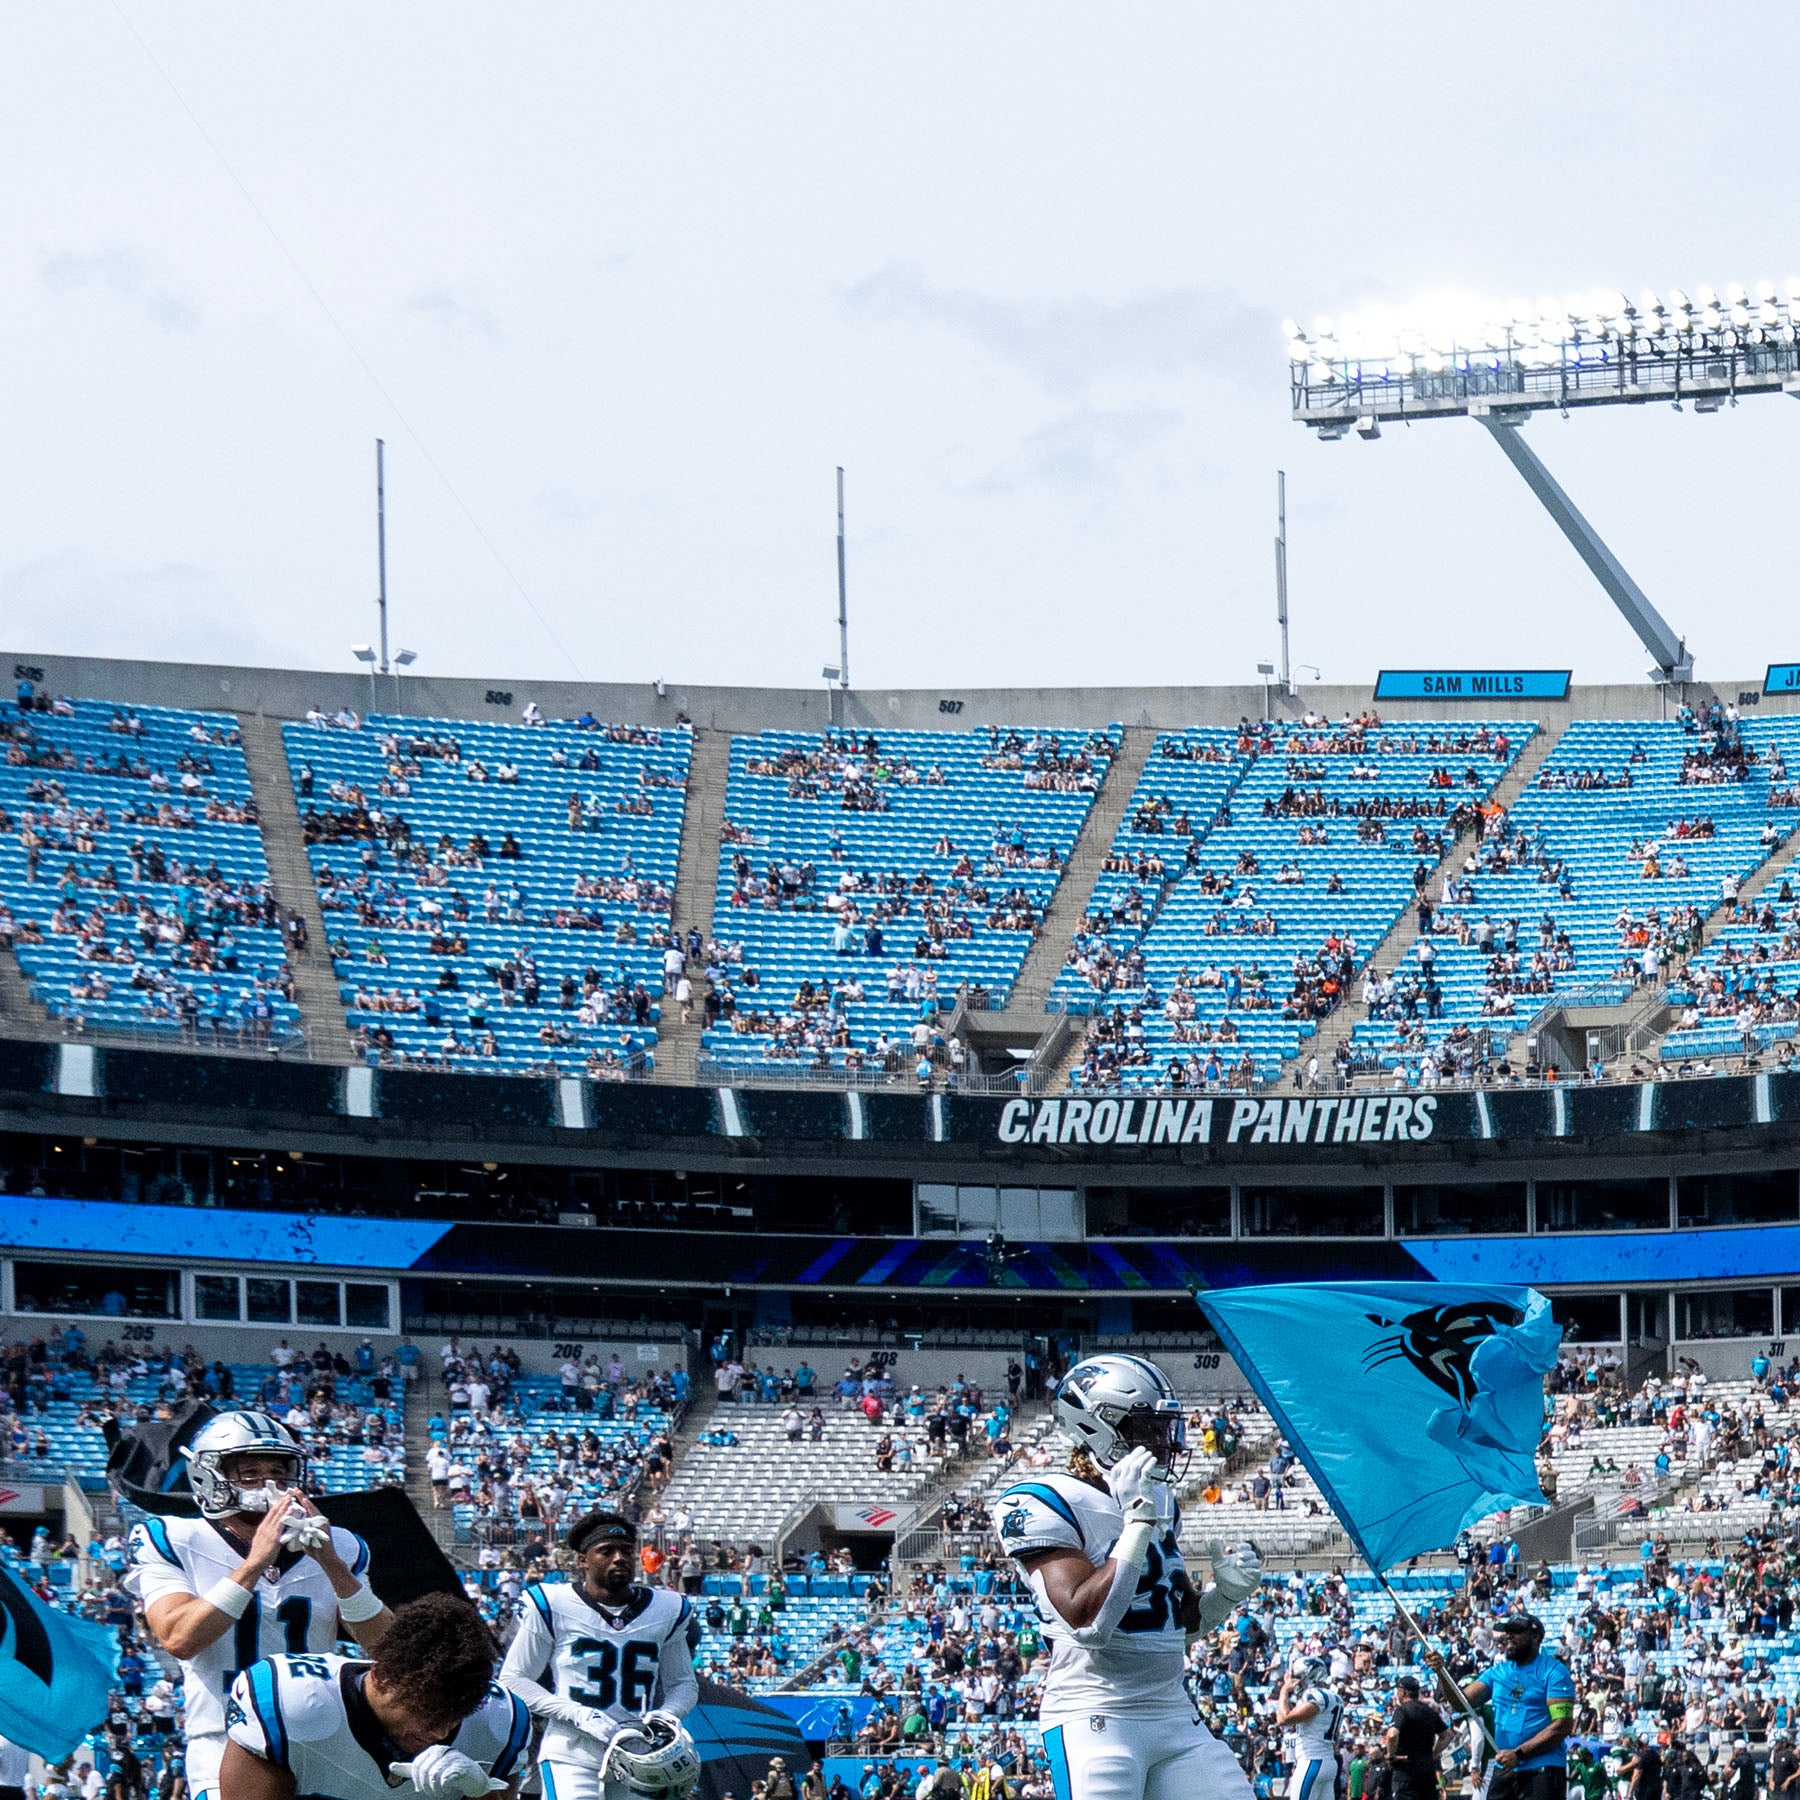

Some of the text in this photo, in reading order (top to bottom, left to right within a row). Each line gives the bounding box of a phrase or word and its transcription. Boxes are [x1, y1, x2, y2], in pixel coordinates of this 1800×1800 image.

[1423, 676, 1524, 694] SAM MILLS
[939, 700, 964, 714] 507
[1738, 692, 1760, 706] 509
[999, 1095, 1438, 1143] CAROLINA PANTHERS
[1769, 1342, 1785, 1357] 311
[1194, 1355, 1221, 1369] 309
[224, 1592, 311, 1693] 11
[569, 1640, 660, 1712] 36
[672, 1755, 690, 1772] 36
